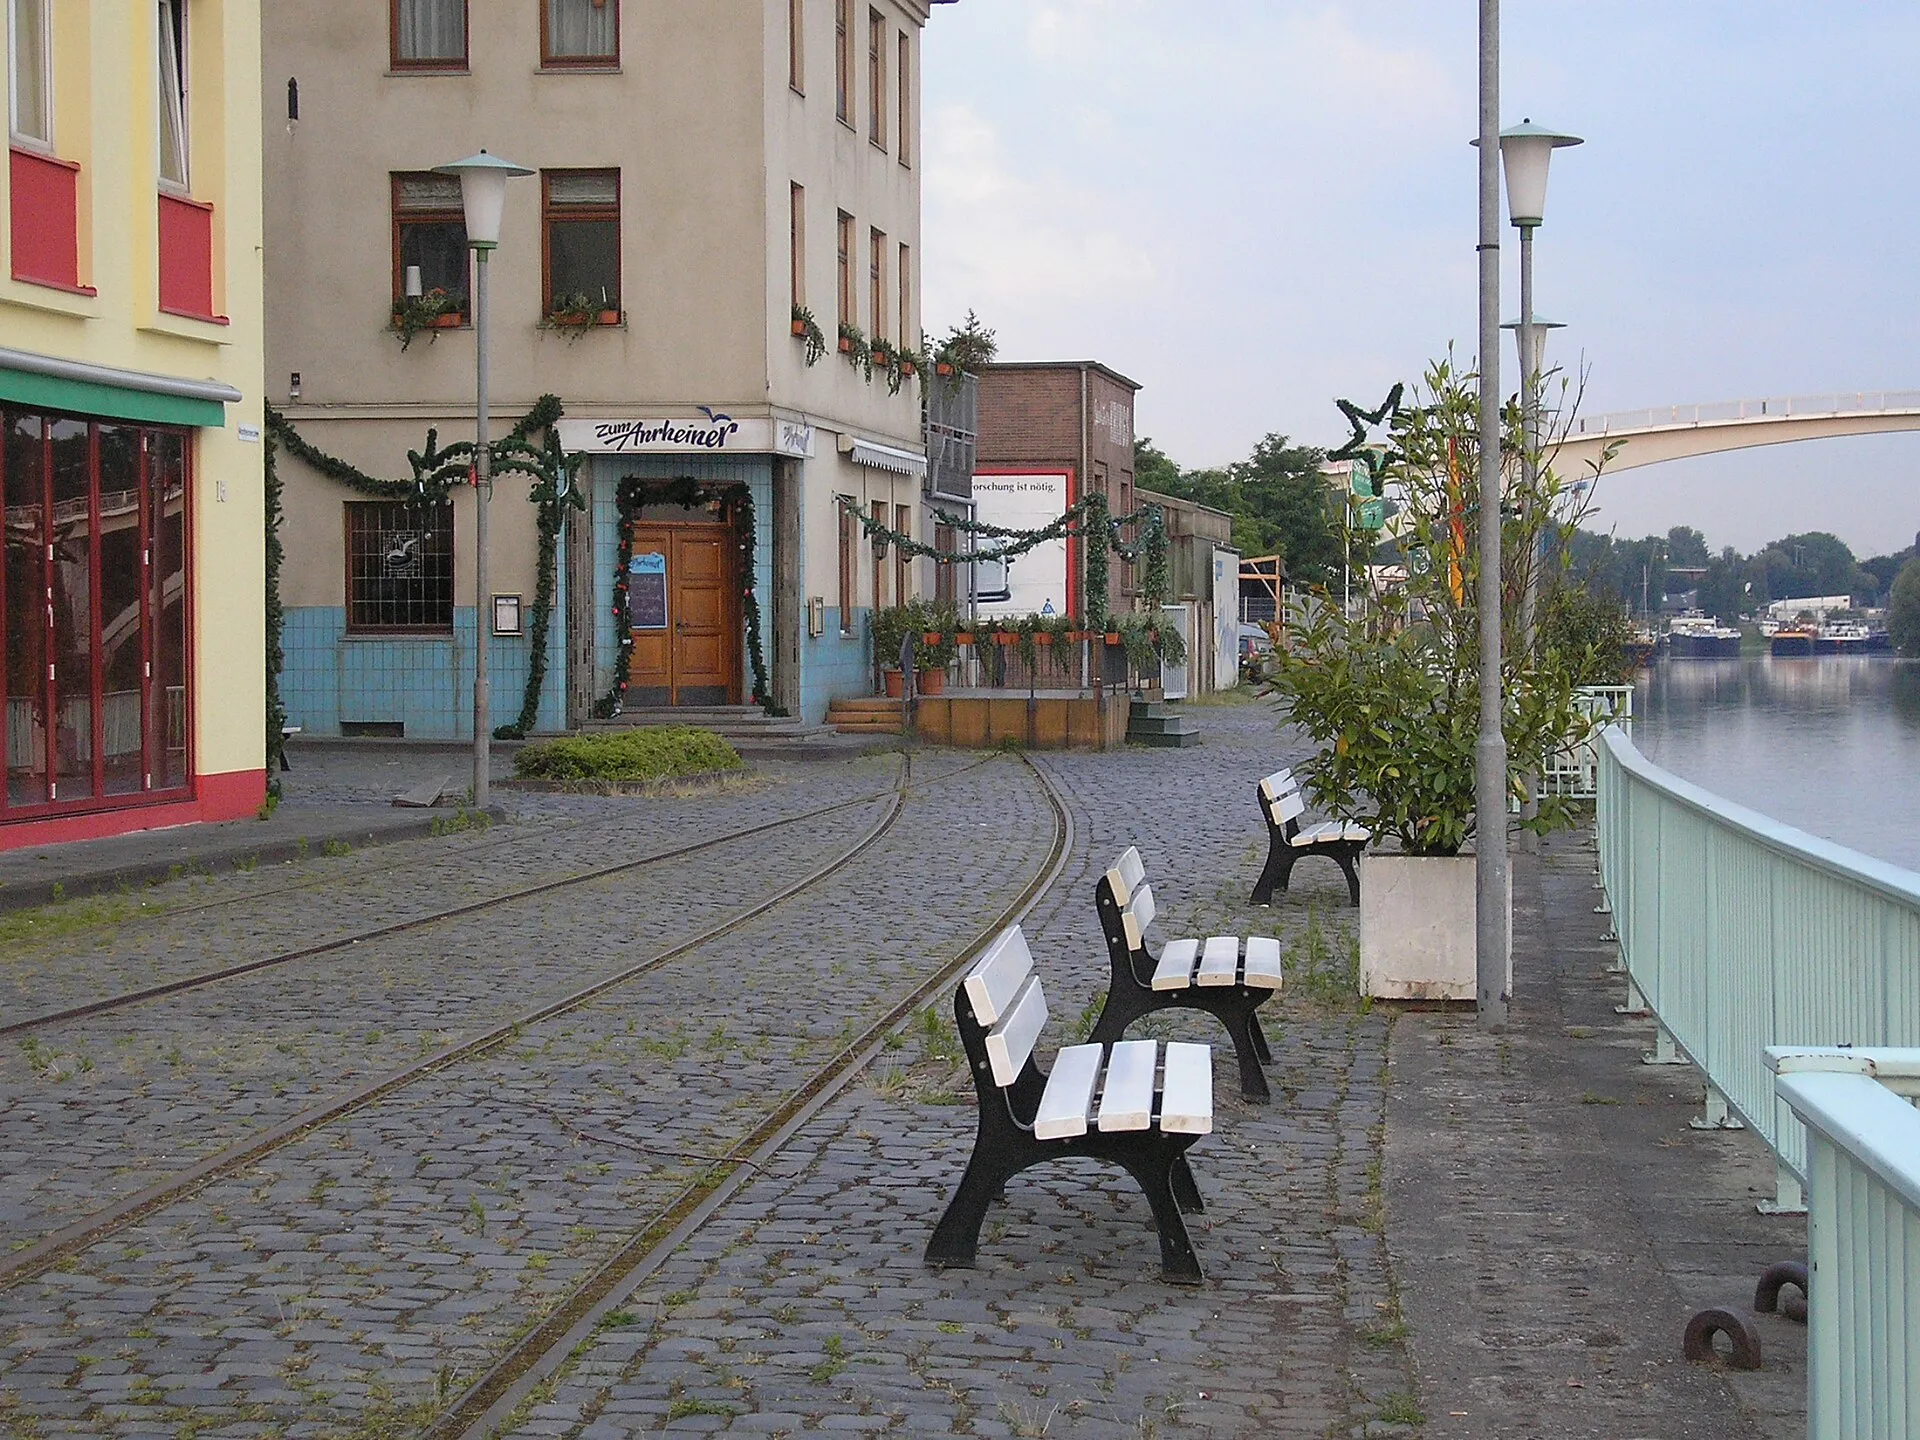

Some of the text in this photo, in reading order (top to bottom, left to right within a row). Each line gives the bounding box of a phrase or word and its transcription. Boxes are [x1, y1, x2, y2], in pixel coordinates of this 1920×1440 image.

[603, 419, 738, 451] Anrheiner
[973, 482, 1056, 493] orschung ist nötig.
